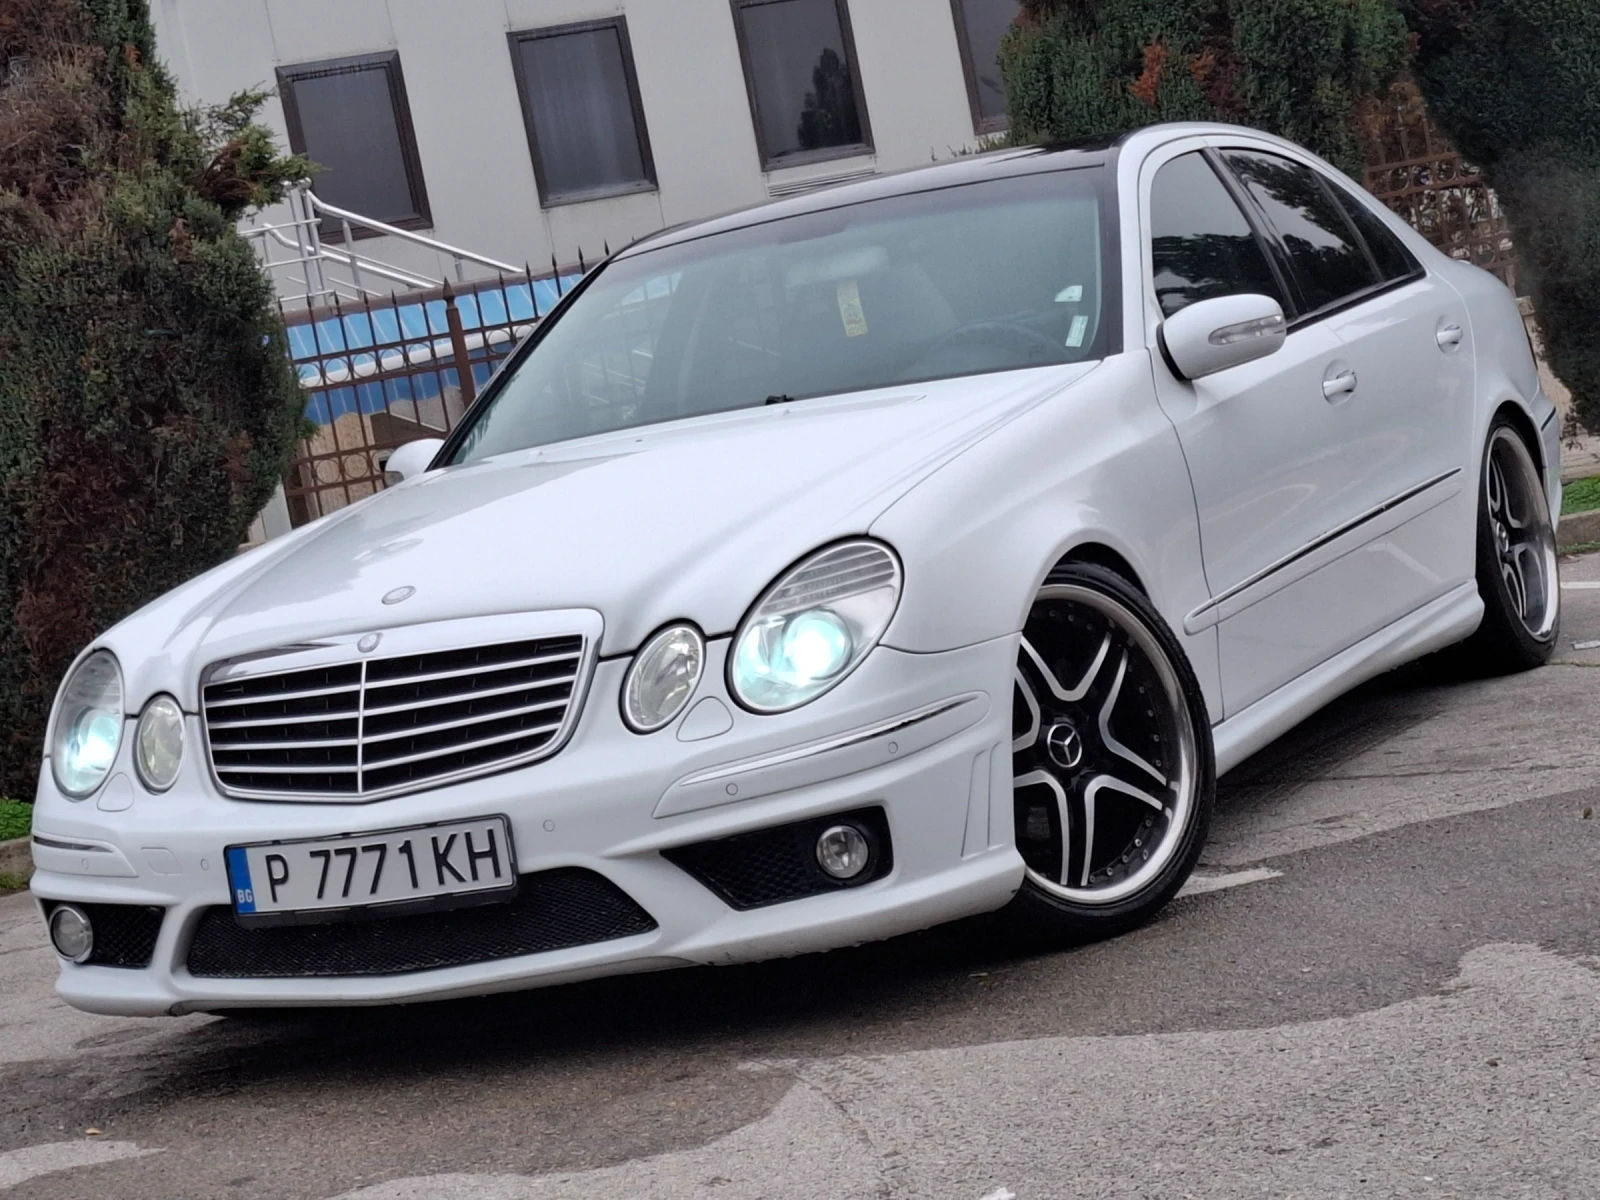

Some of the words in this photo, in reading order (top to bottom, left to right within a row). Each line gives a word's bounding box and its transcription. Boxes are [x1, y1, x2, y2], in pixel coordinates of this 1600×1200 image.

[265, 853, 289, 903] P
[309, 840, 419, 900] 7771
[431, 828, 502, 885] KH
[237, 888, 253, 903] BG
